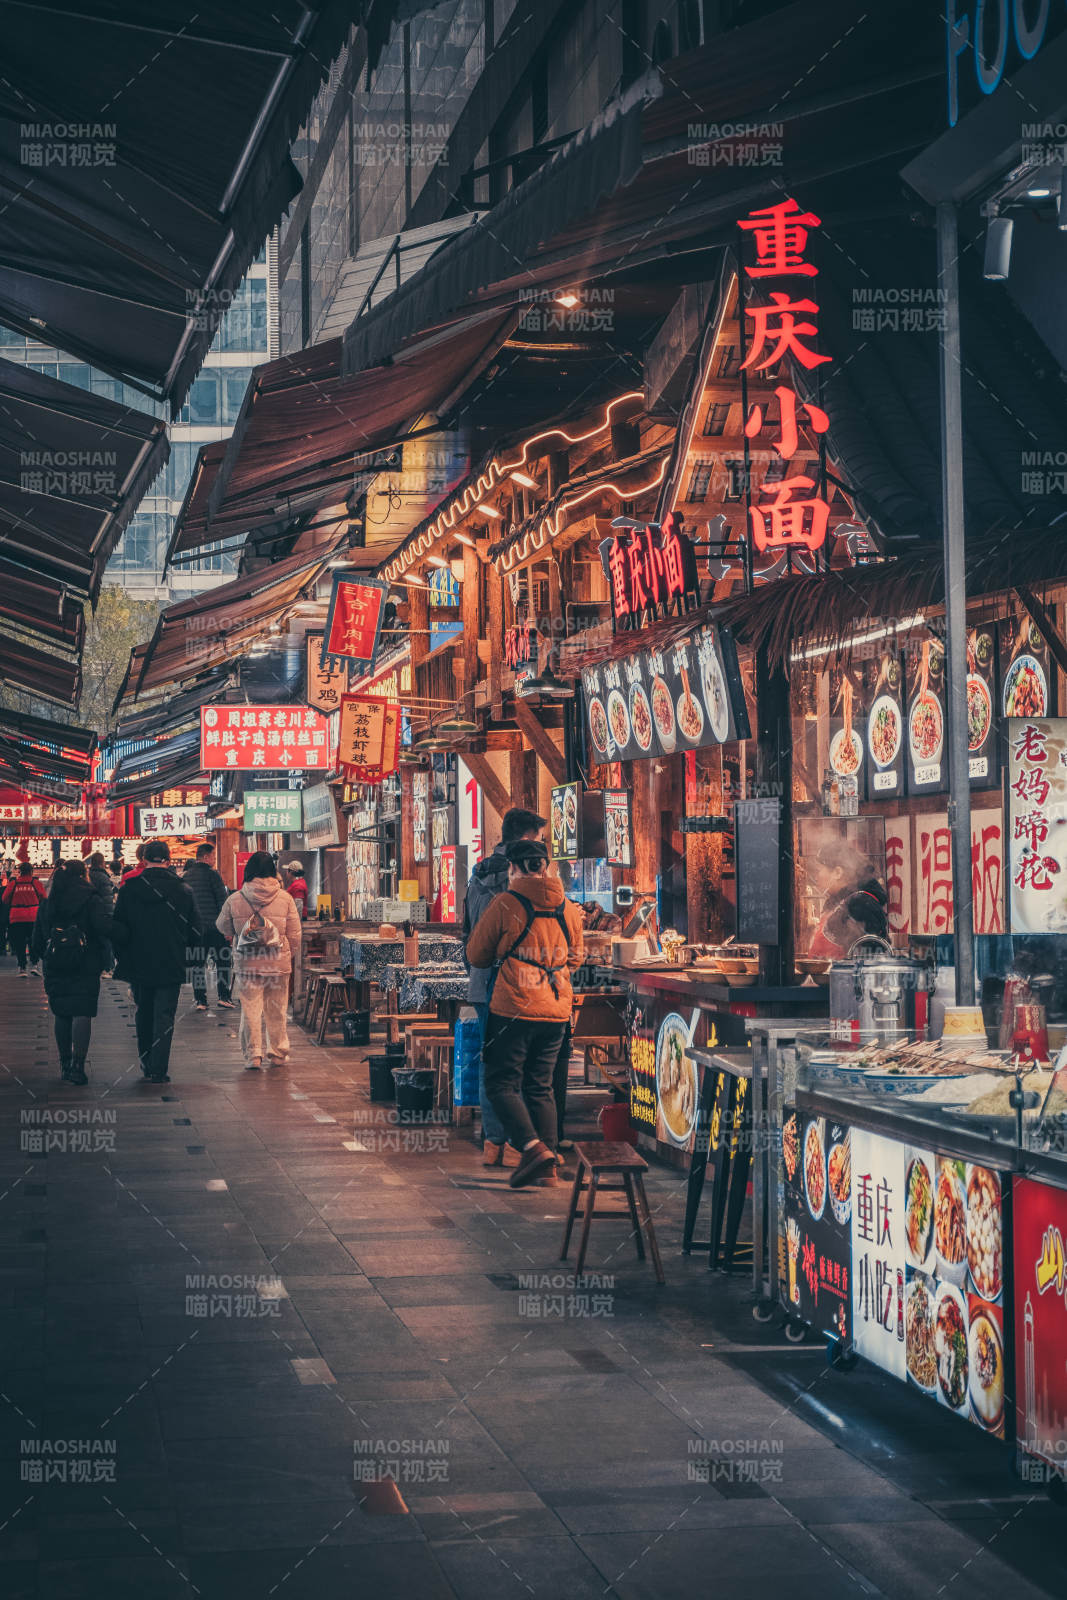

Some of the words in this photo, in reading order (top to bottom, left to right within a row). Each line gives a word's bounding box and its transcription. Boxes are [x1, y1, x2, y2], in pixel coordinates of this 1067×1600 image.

[736, 198, 833, 552] 重庆小面
[610, 511, 685, 618] 重庆小面
[343, 599, 369, 656] 合川肉片
[227, 710, 317, 728] 周姐家老川菜
[351, 713, 371, 765] 荔枝虾球
[225, 749, 319, 766] 重庆小面
[143, 812, 208, 832] 重庆小面
[1011, 723, 1053, 891] 老妈蹄花
[857, 1173, 893, 1249] 重庆
[858, 1253, 894, 1334] 小吃
